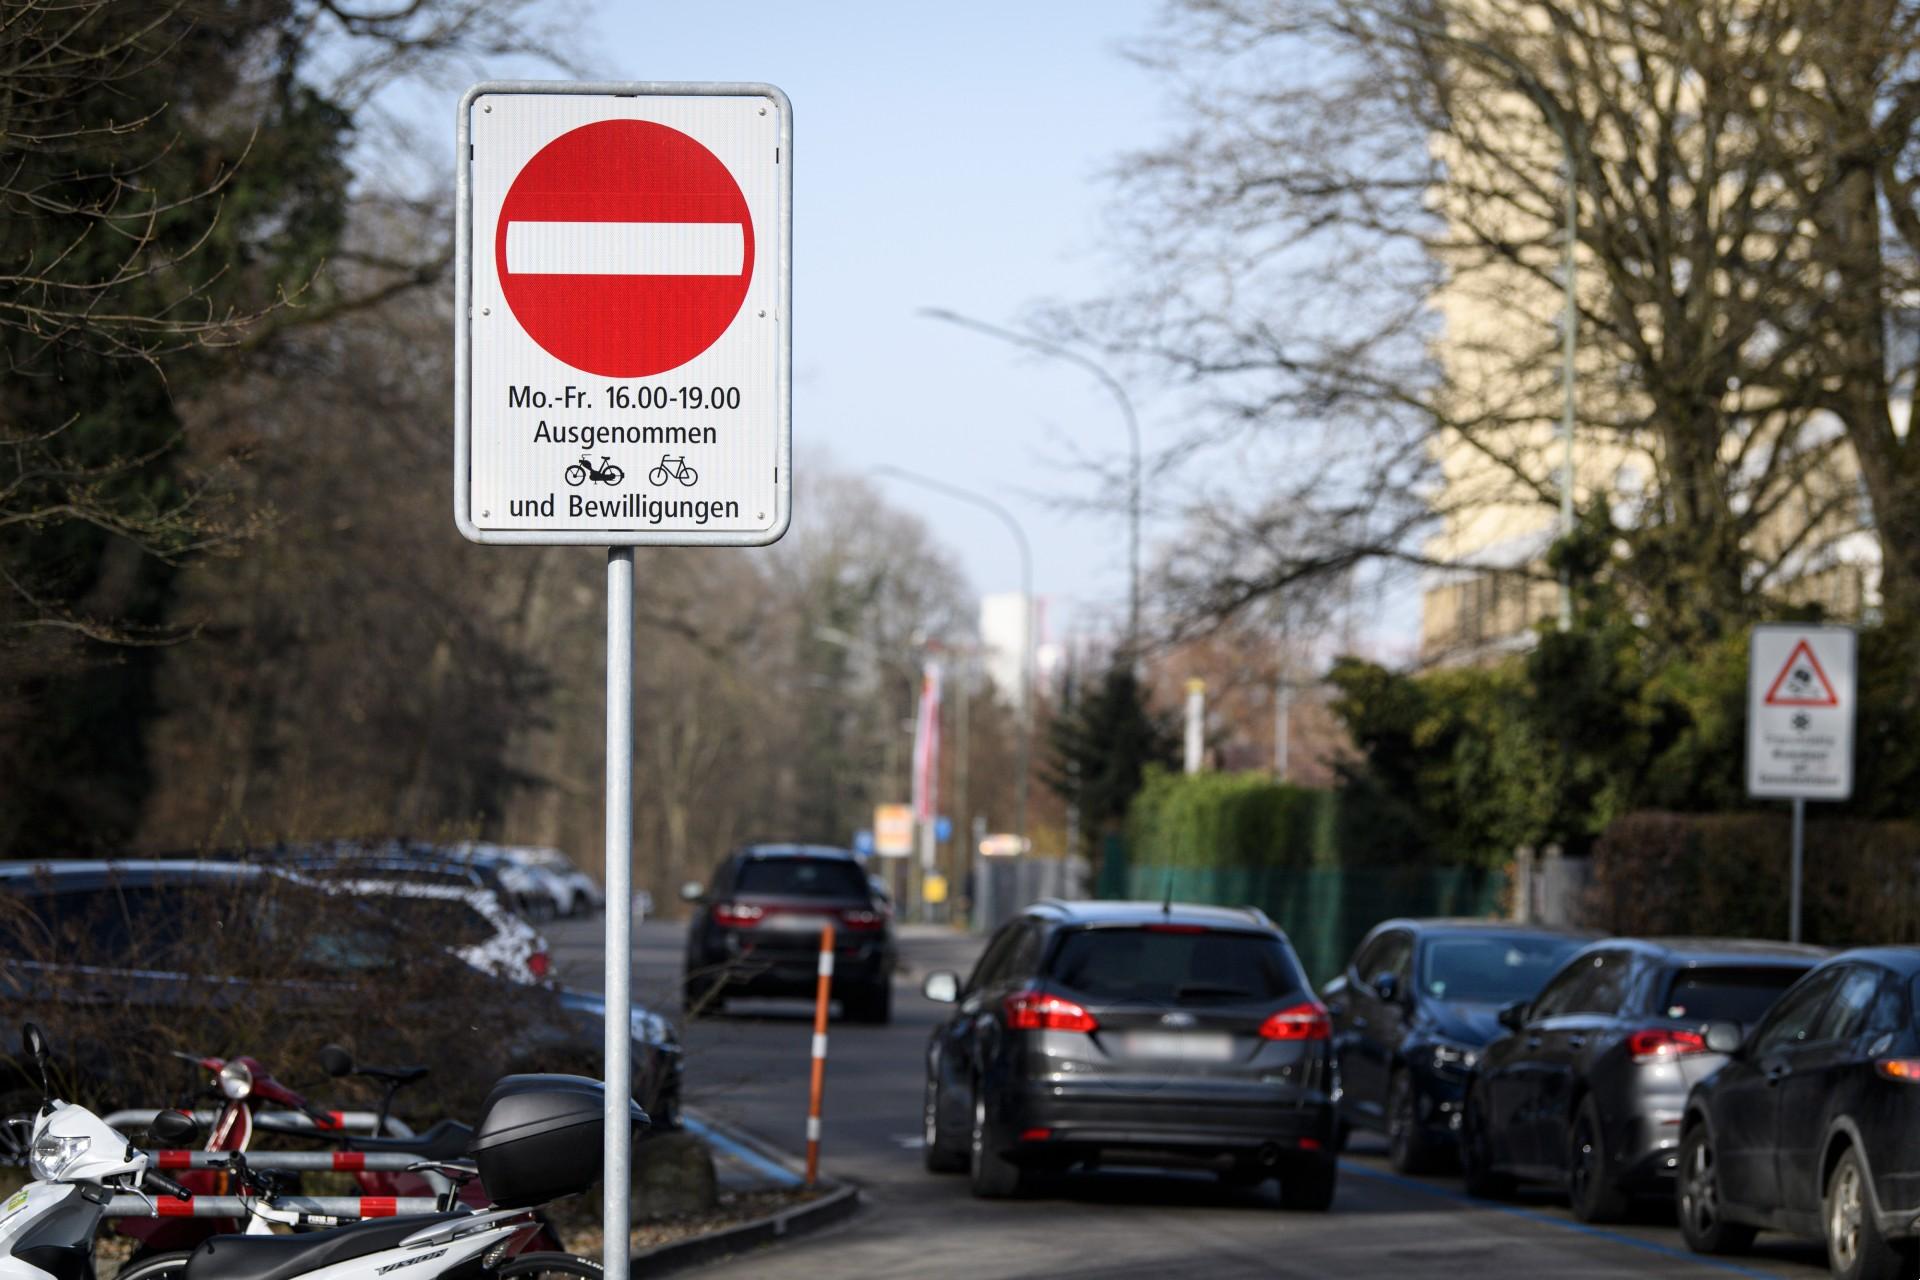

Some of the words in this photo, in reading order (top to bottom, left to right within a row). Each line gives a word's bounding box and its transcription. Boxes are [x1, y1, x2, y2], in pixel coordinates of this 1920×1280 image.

[509, 385, 592, 409] Mo.-Fr.
[606, 385, 741, 409] 16.00-19.00
[533, 420, 717, 450] Ausgenommen
[510, 492, 555, 517] und
[569, 493, 739, 525] Bewilligungen
[375, 1247, 449, 1276] VISION
